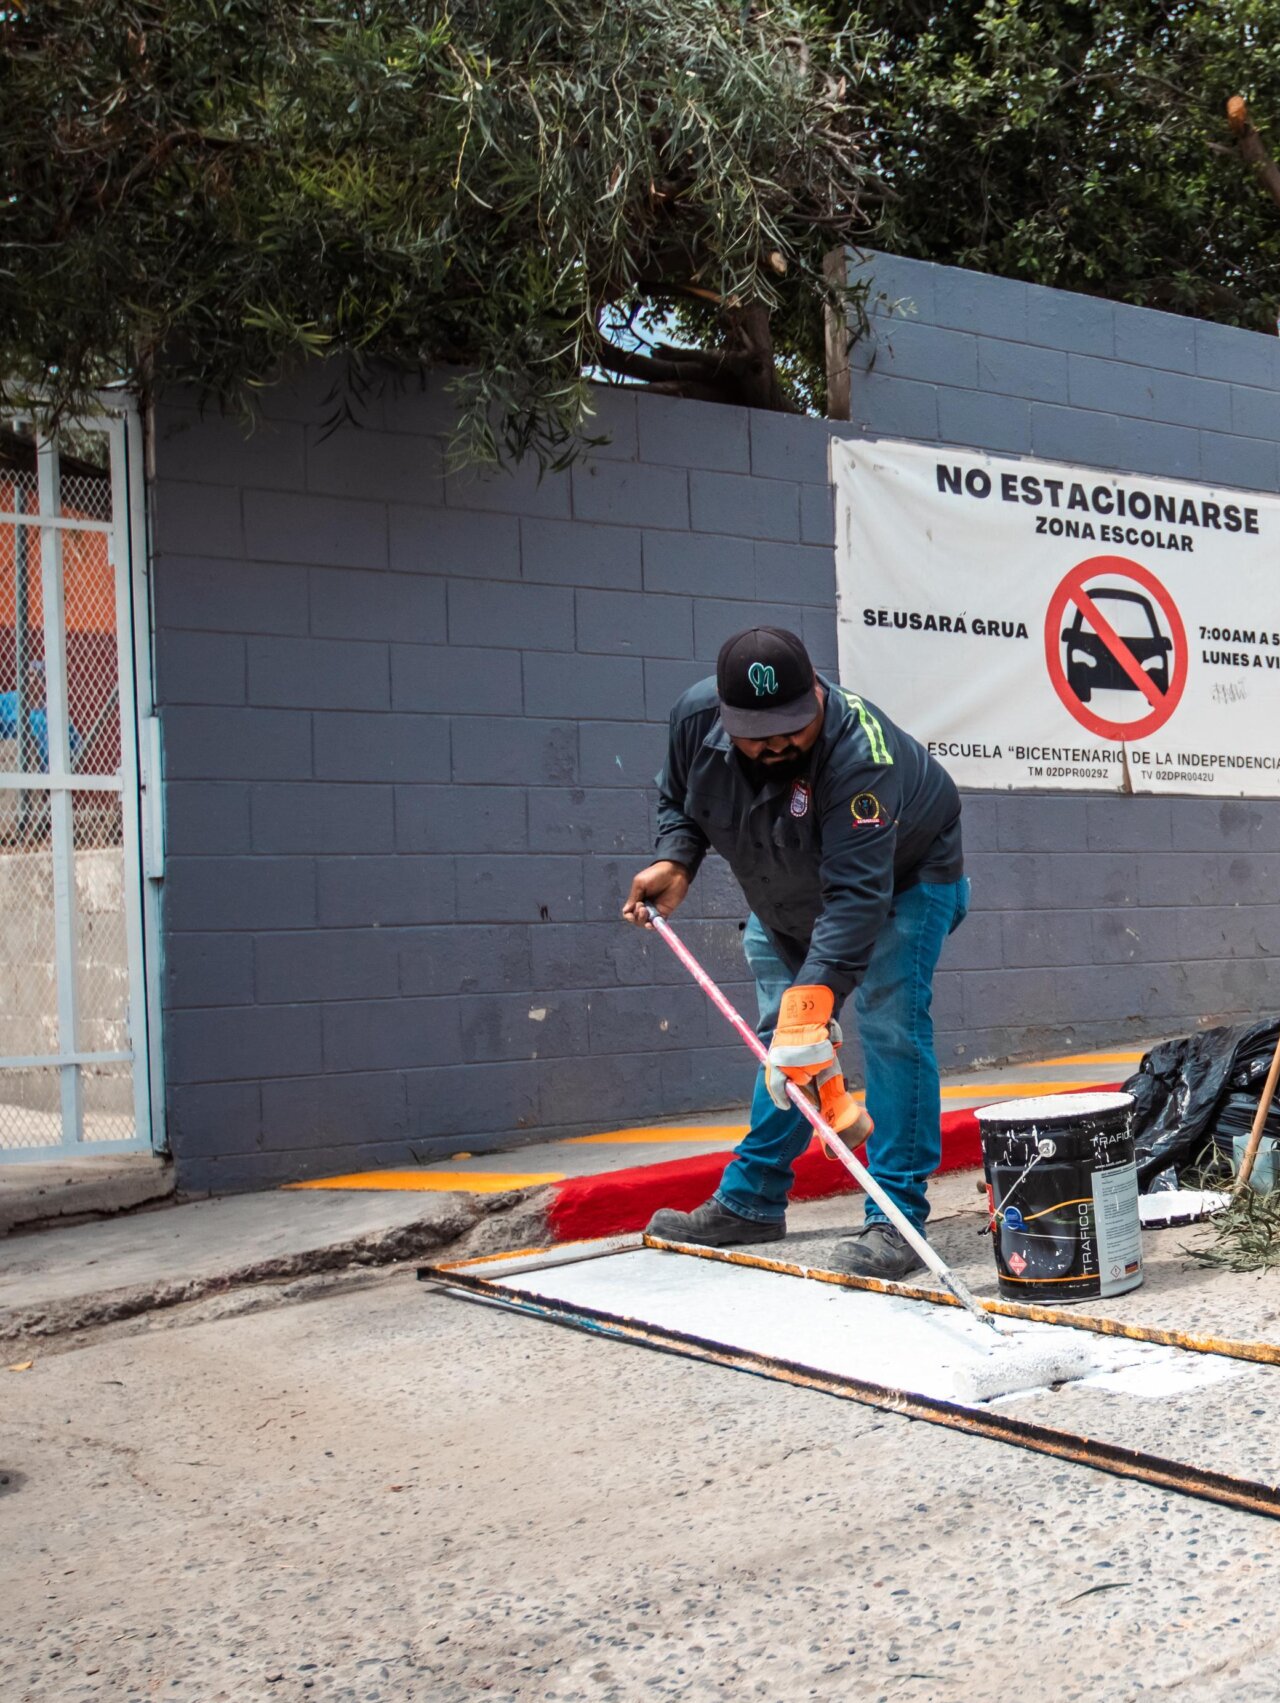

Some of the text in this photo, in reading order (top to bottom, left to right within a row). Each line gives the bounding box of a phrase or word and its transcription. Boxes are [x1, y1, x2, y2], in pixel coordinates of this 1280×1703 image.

[936, 464, 1259, 534] NO ESTACIONARSE
[1035, 516, 1194, 552] ZONA ESCOLAR
[863, 608, 889, 627] SE
[971, 618, 1029, 639] GRUA
[1199, 626, 1256, 644] 7:00AM
[1259, 632, 1269, 645] A
[1202, 650, 1250, 667] LUNES
[1253, 655, 1262, 668] A
[927, 742, 1002, 759] ESCUELA
[1132, 751, 1150, 764] DE
[1156, 752, 1173, 765] LA
[1028, 766, 1043, 776] TM
[1141, 770, 1152, 780] TV
[1078, 1203, 1093, 1275] TRAFICO
